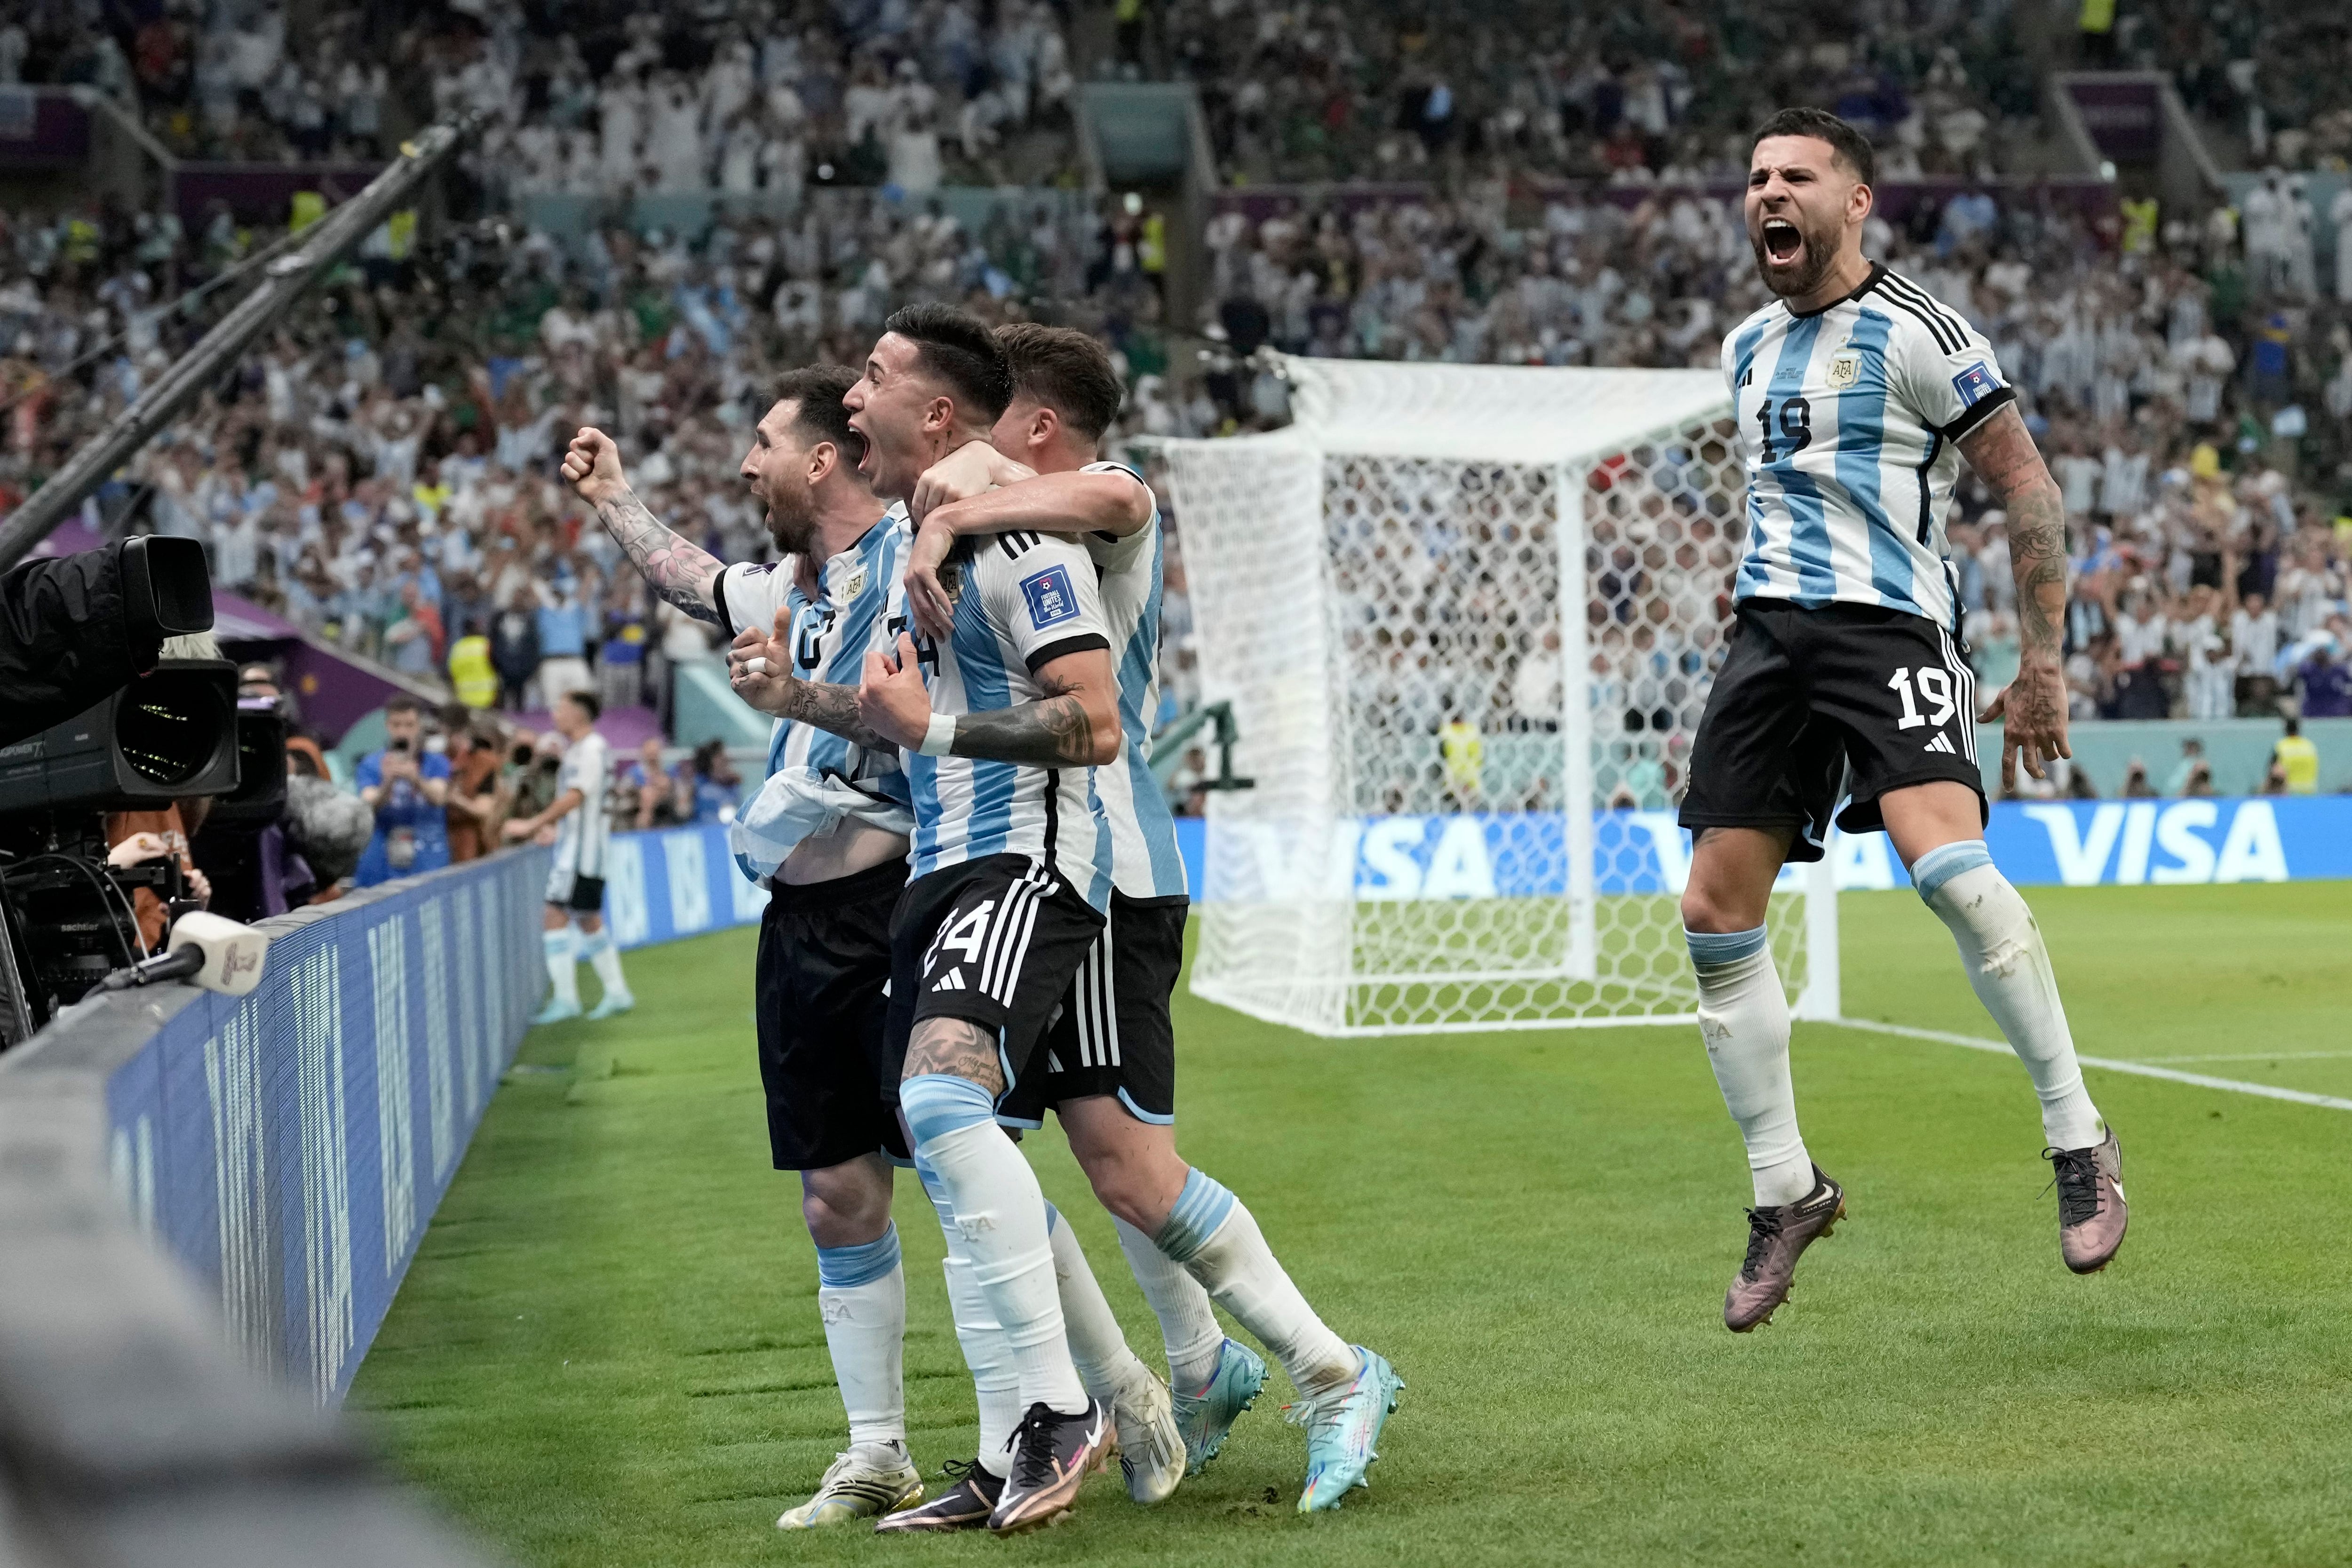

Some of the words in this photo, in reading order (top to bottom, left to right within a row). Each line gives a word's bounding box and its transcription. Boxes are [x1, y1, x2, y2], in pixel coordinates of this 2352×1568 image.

[1833, 360, 1851, 378] AFA
[1756, 398, 1812, 464] 19
[847, 575, 861, 595] AFA
[1041, 589, 1059, 601] FOOTBALL
[1042, 594, 1062, 607] UNITES
[1888, 666, 1955, 731] 19
[2022, 800, 2290, 885] VISA
[923, 899, 995, 979] 24
